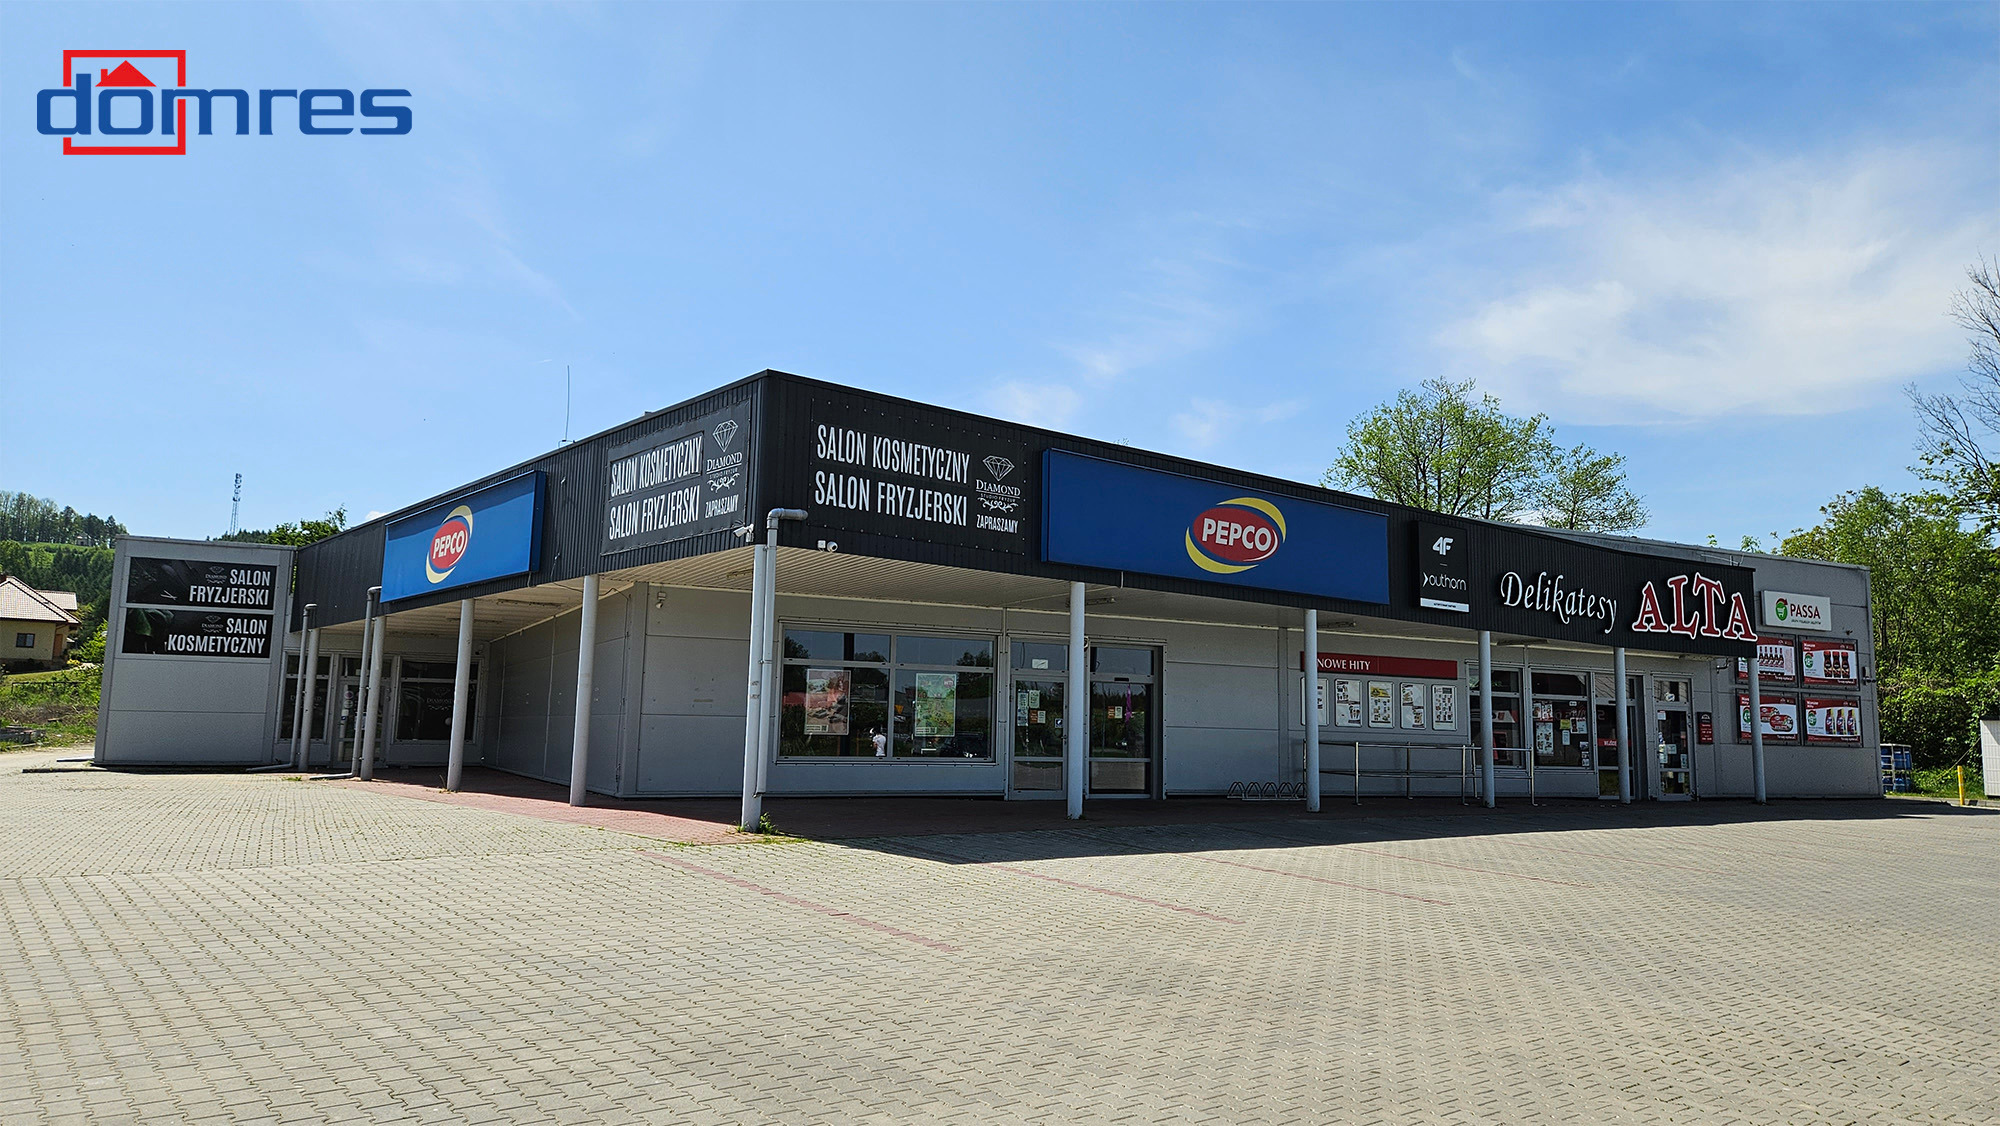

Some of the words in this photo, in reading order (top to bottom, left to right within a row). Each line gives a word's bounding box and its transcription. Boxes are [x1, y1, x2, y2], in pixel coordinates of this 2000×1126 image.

[706, 451, 743, 472] DIAMOND
[817, 423, 867, 466] SALON
[872, 435, 970, 484] KOSMETYCZNY
[610, 457, 638, 498] SALON
[639, 435, 703, 489] KOSMETYCZNY
[975, 478, 1021, 496] DIAMOND
[704, 494, 740, 519] ZAPRASZAMY
[815, 470, 870, 512] SALON
[877, 481, 967, 527] FRYZJERSKI
[609, 500, 640, 541] SALON
[641, 485, 700, 533] FRYZJERSKI
[976, 514, 1019, 534] ZAPRASZAMY
[1202, 517, 1272, 552] PEPCO
[432, 530, 465, 560] PEPCO
[1432, 536, 1454, 556] 4F
[229, 568, 271, 587] SALON
[189, 585, 270, 606] FRYZJERSKI
[1500, 571, 1617, 635] Delikatesy
[1631, 572, 1759, 642] ALTA
[1790, 603, 1821, 619] PASSA
[226, 617, 267, 635] SALON
[167, 634, 266, 655] KOSMETYCZNY
[1317, 657, 1347, 670] NOWE
[1349, 660, 1371, 671] HITY
